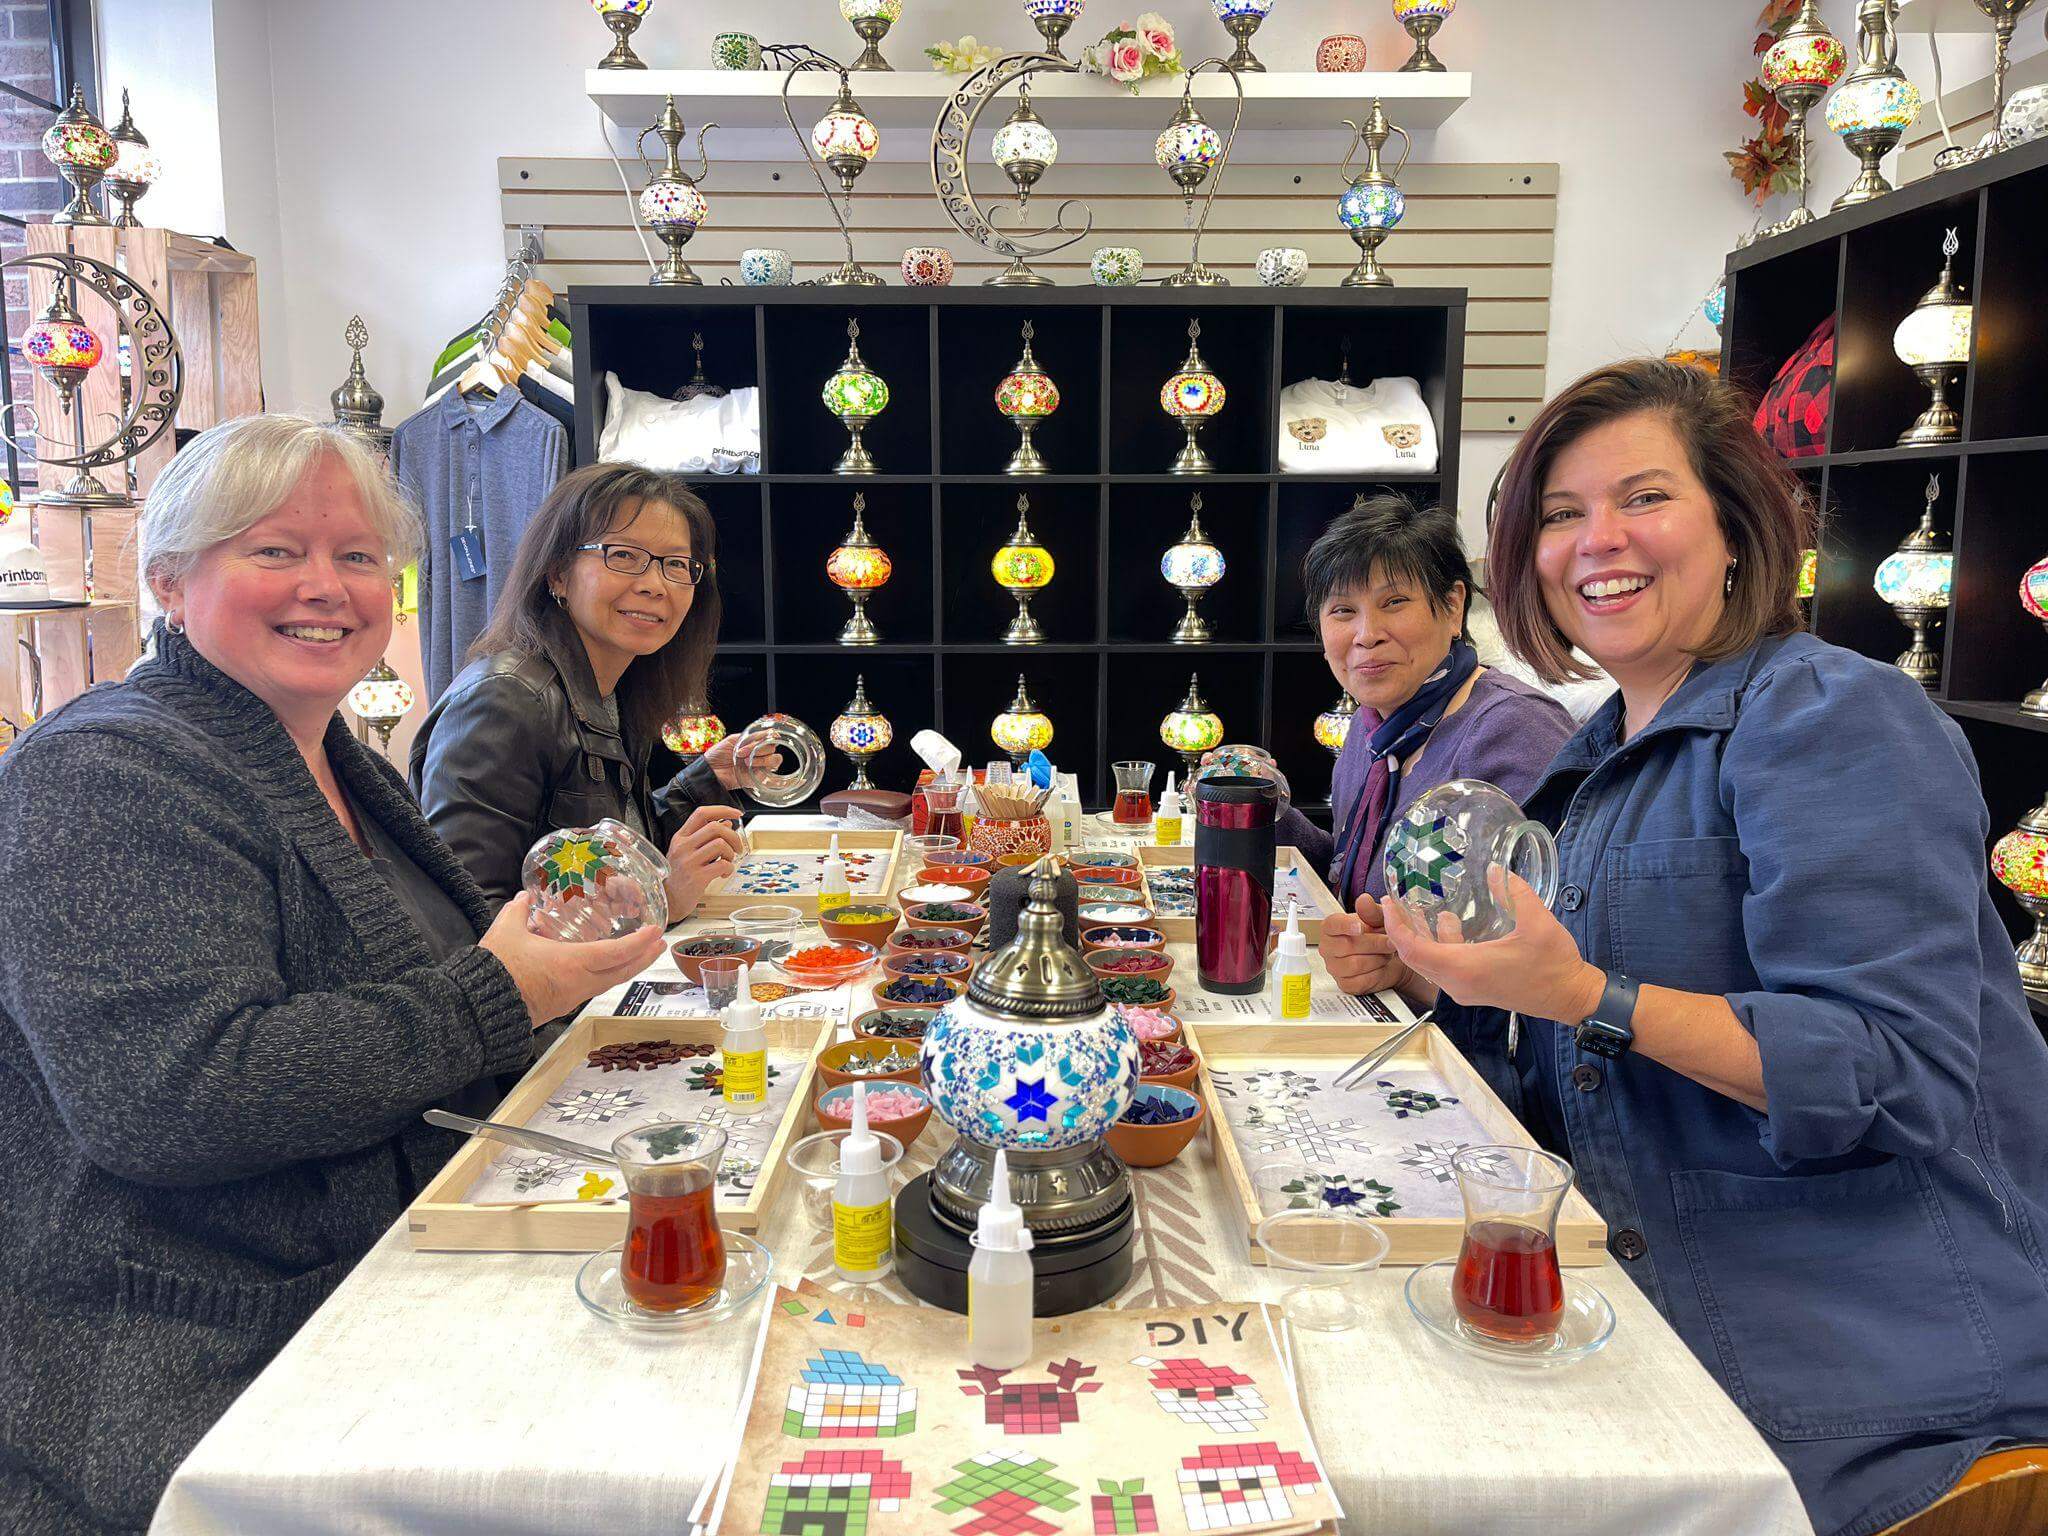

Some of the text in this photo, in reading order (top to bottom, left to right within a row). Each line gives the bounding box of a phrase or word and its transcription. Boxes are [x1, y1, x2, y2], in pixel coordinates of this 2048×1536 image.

[1298, 442, 1320, 451] Luna
[1395, 449, 1417, 459] Luna
[1146, 1311, 1249, 1347] DIY
